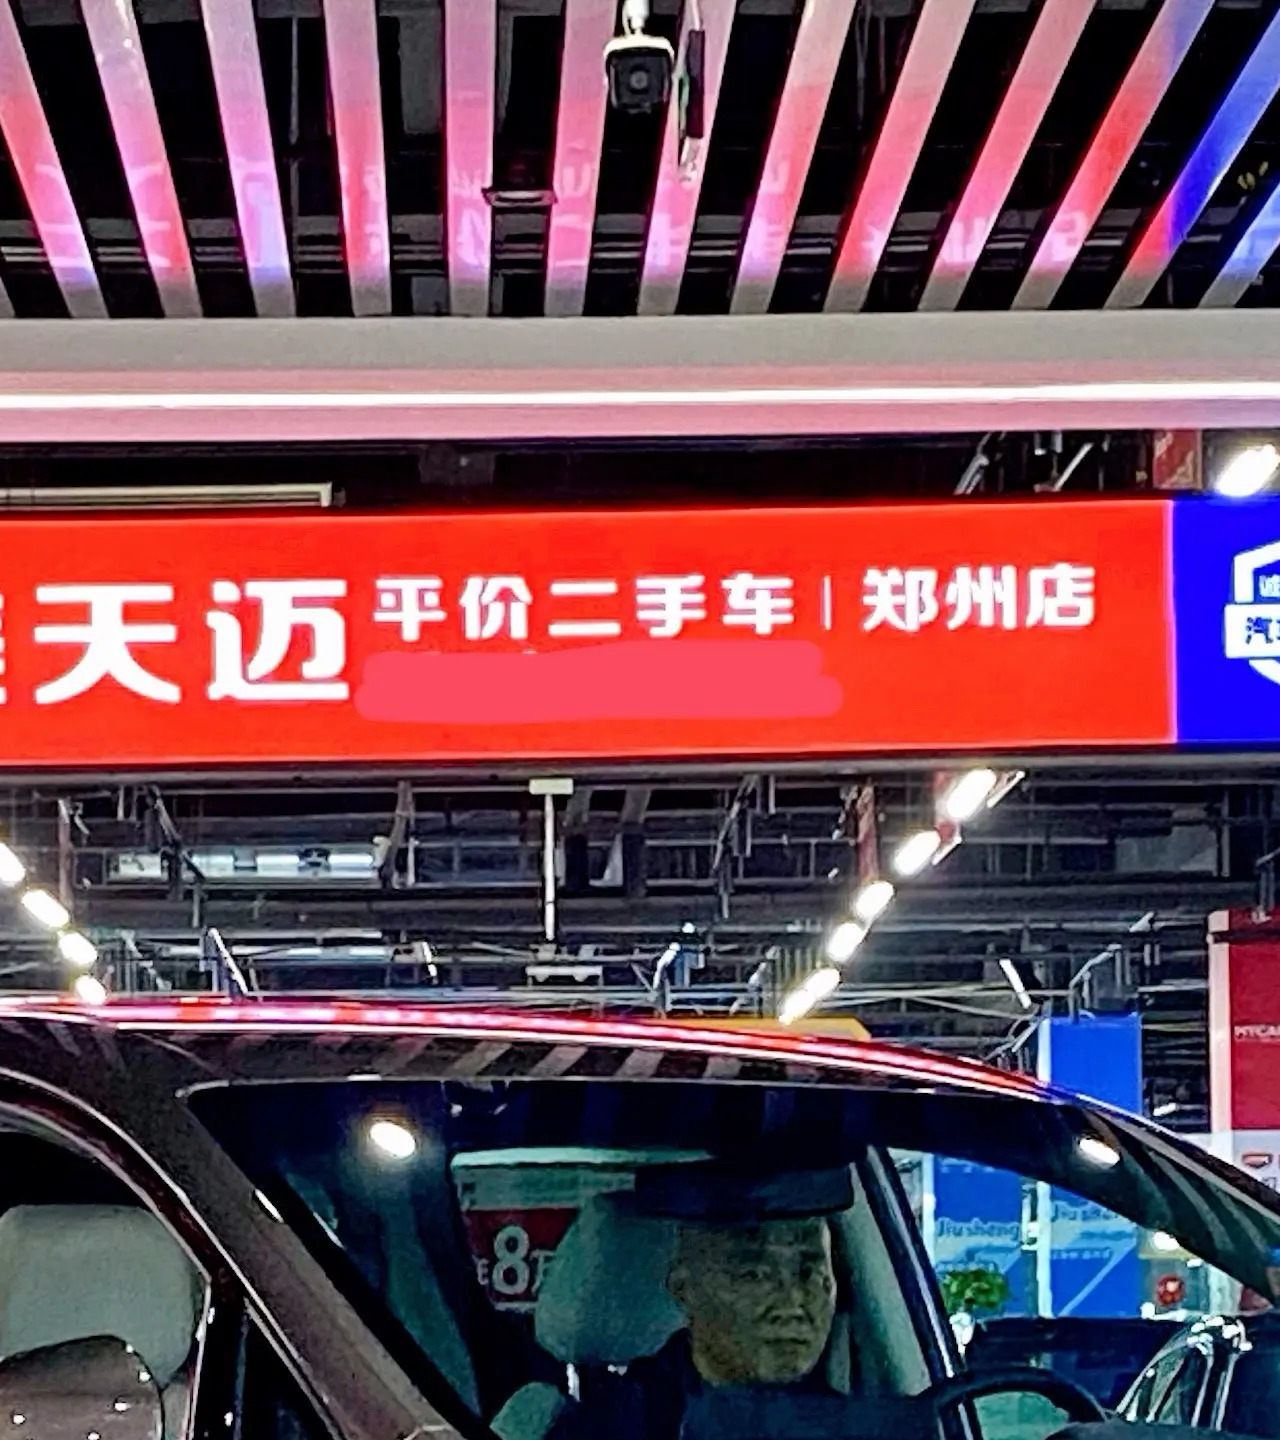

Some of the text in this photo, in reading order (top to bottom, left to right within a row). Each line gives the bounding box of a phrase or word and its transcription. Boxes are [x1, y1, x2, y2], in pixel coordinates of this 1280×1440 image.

[372, 564, 1096, 642] 平价二手车 郑州店
